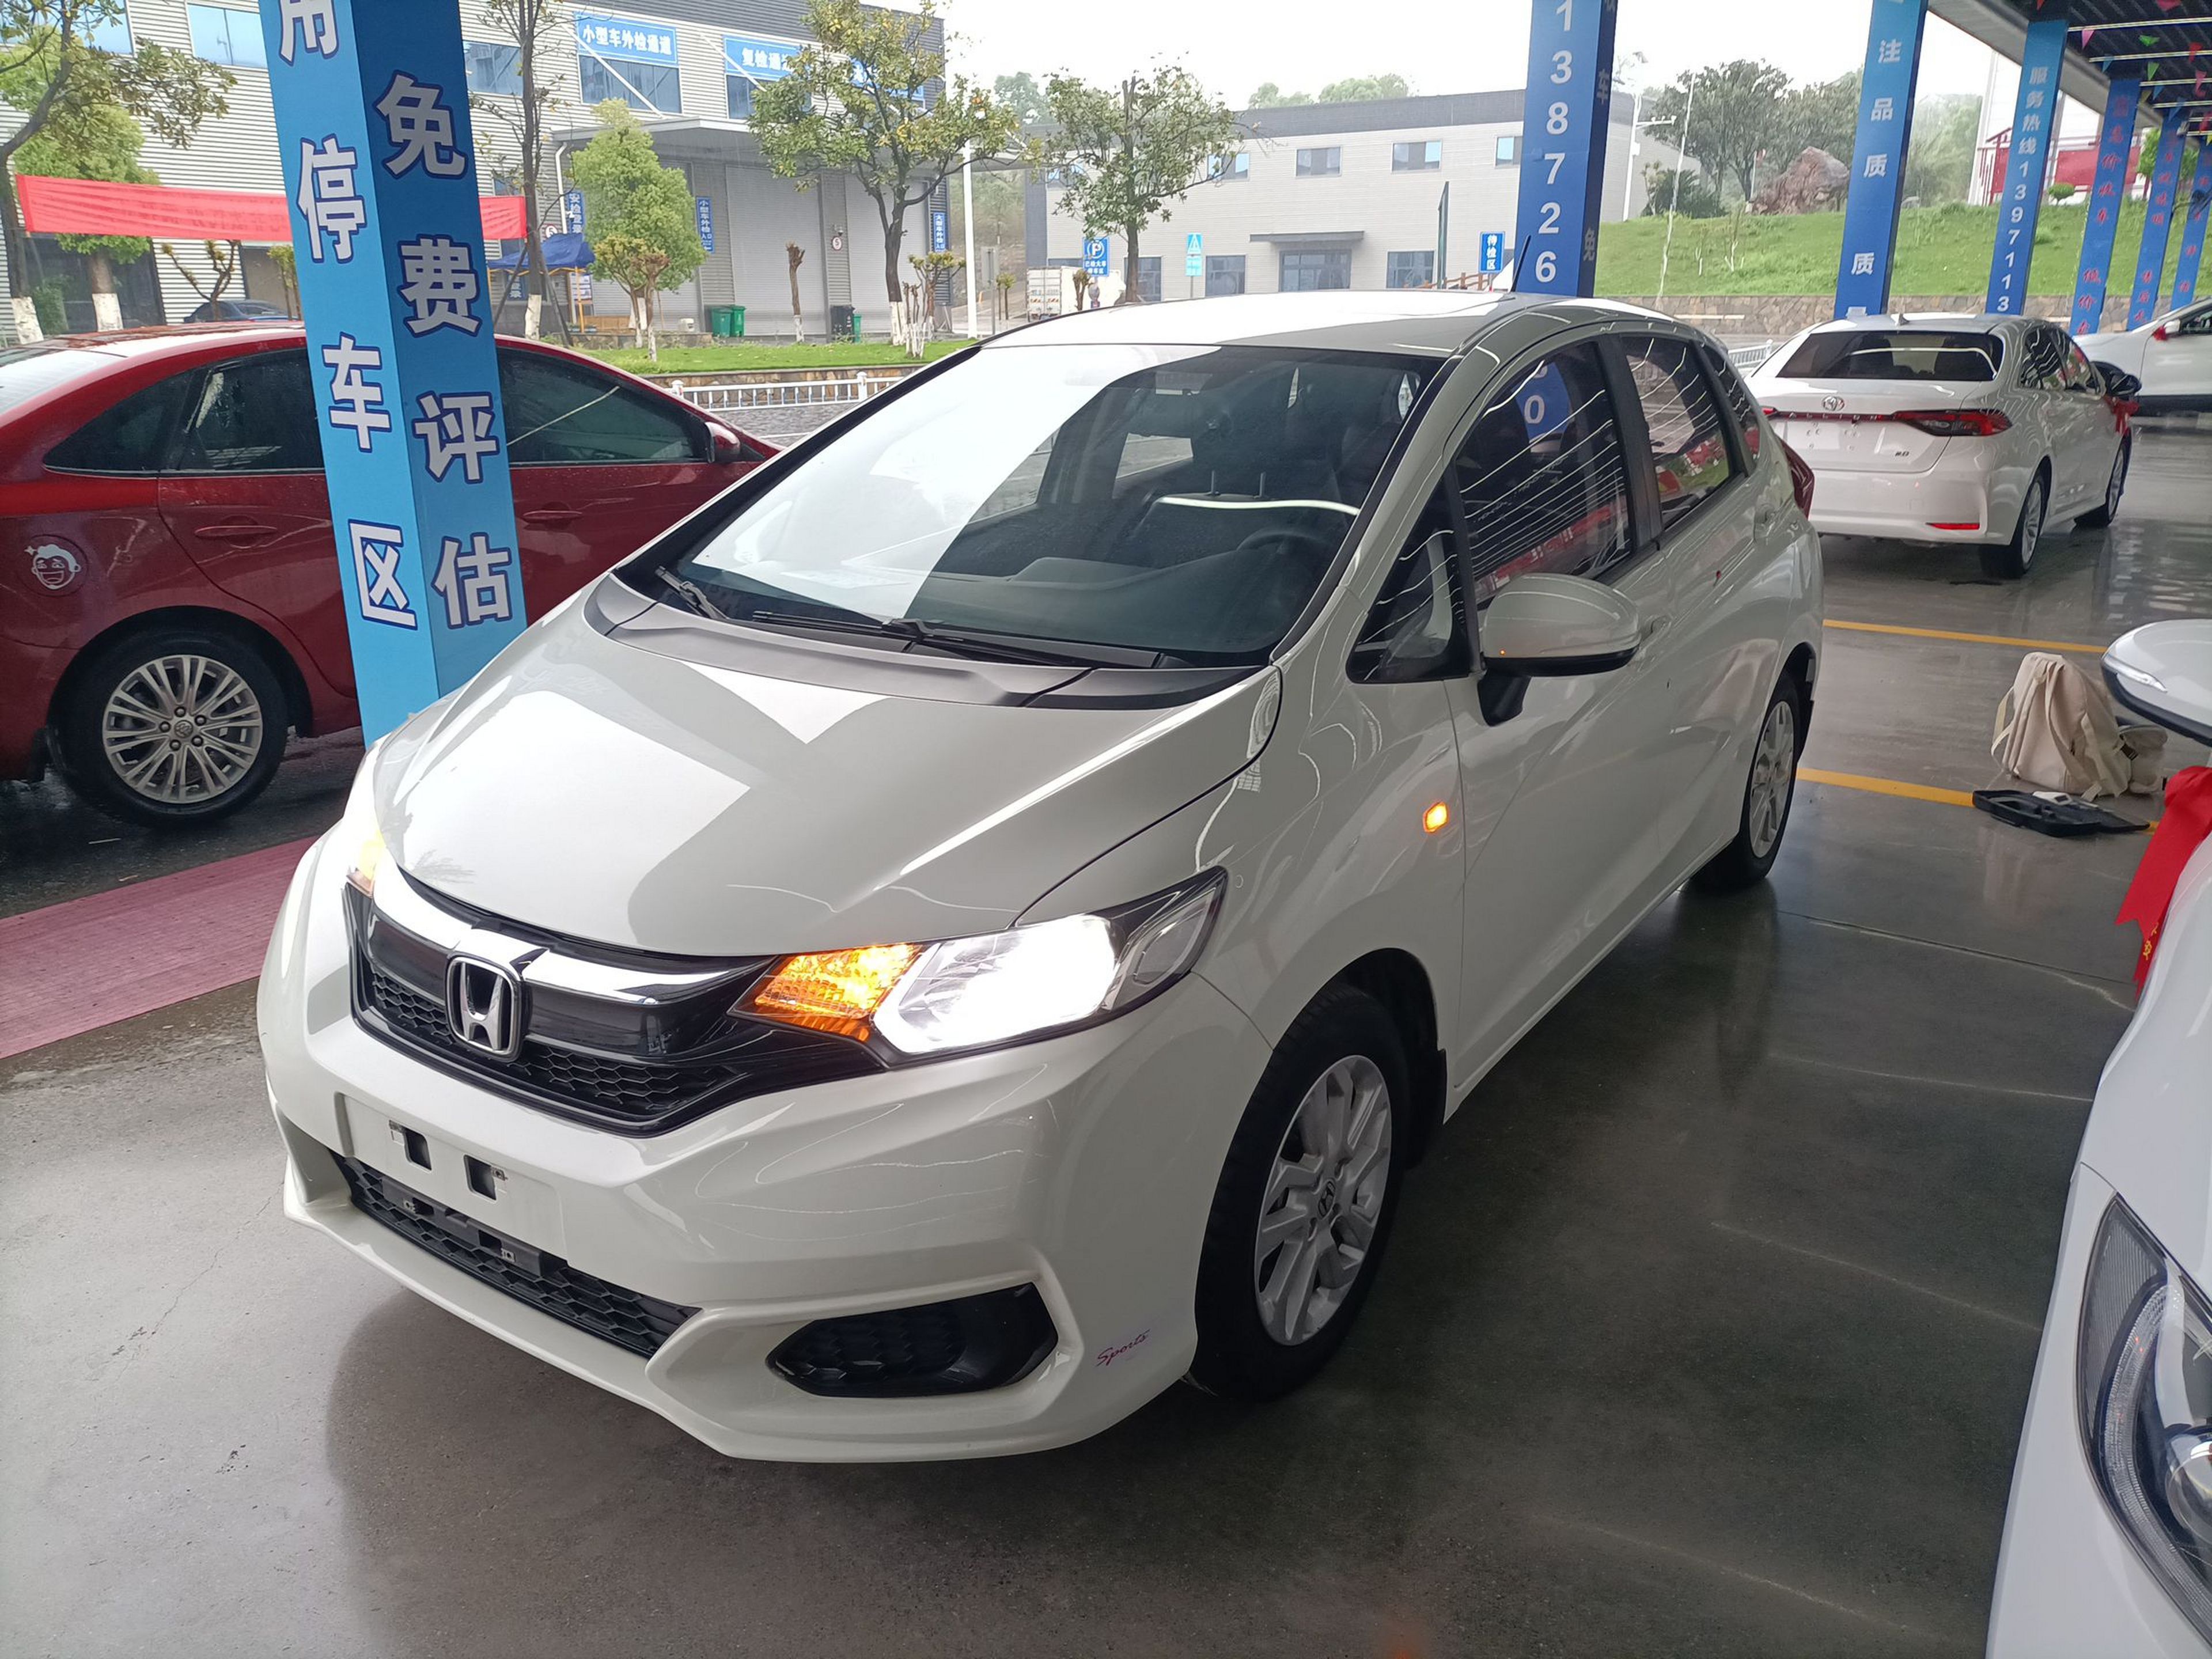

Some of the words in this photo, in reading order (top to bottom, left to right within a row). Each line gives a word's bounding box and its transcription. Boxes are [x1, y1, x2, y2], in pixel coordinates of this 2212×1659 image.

[583, 24, 672, 55] 小型车外检通道
[373, 69, 512, 630] 免费评估
